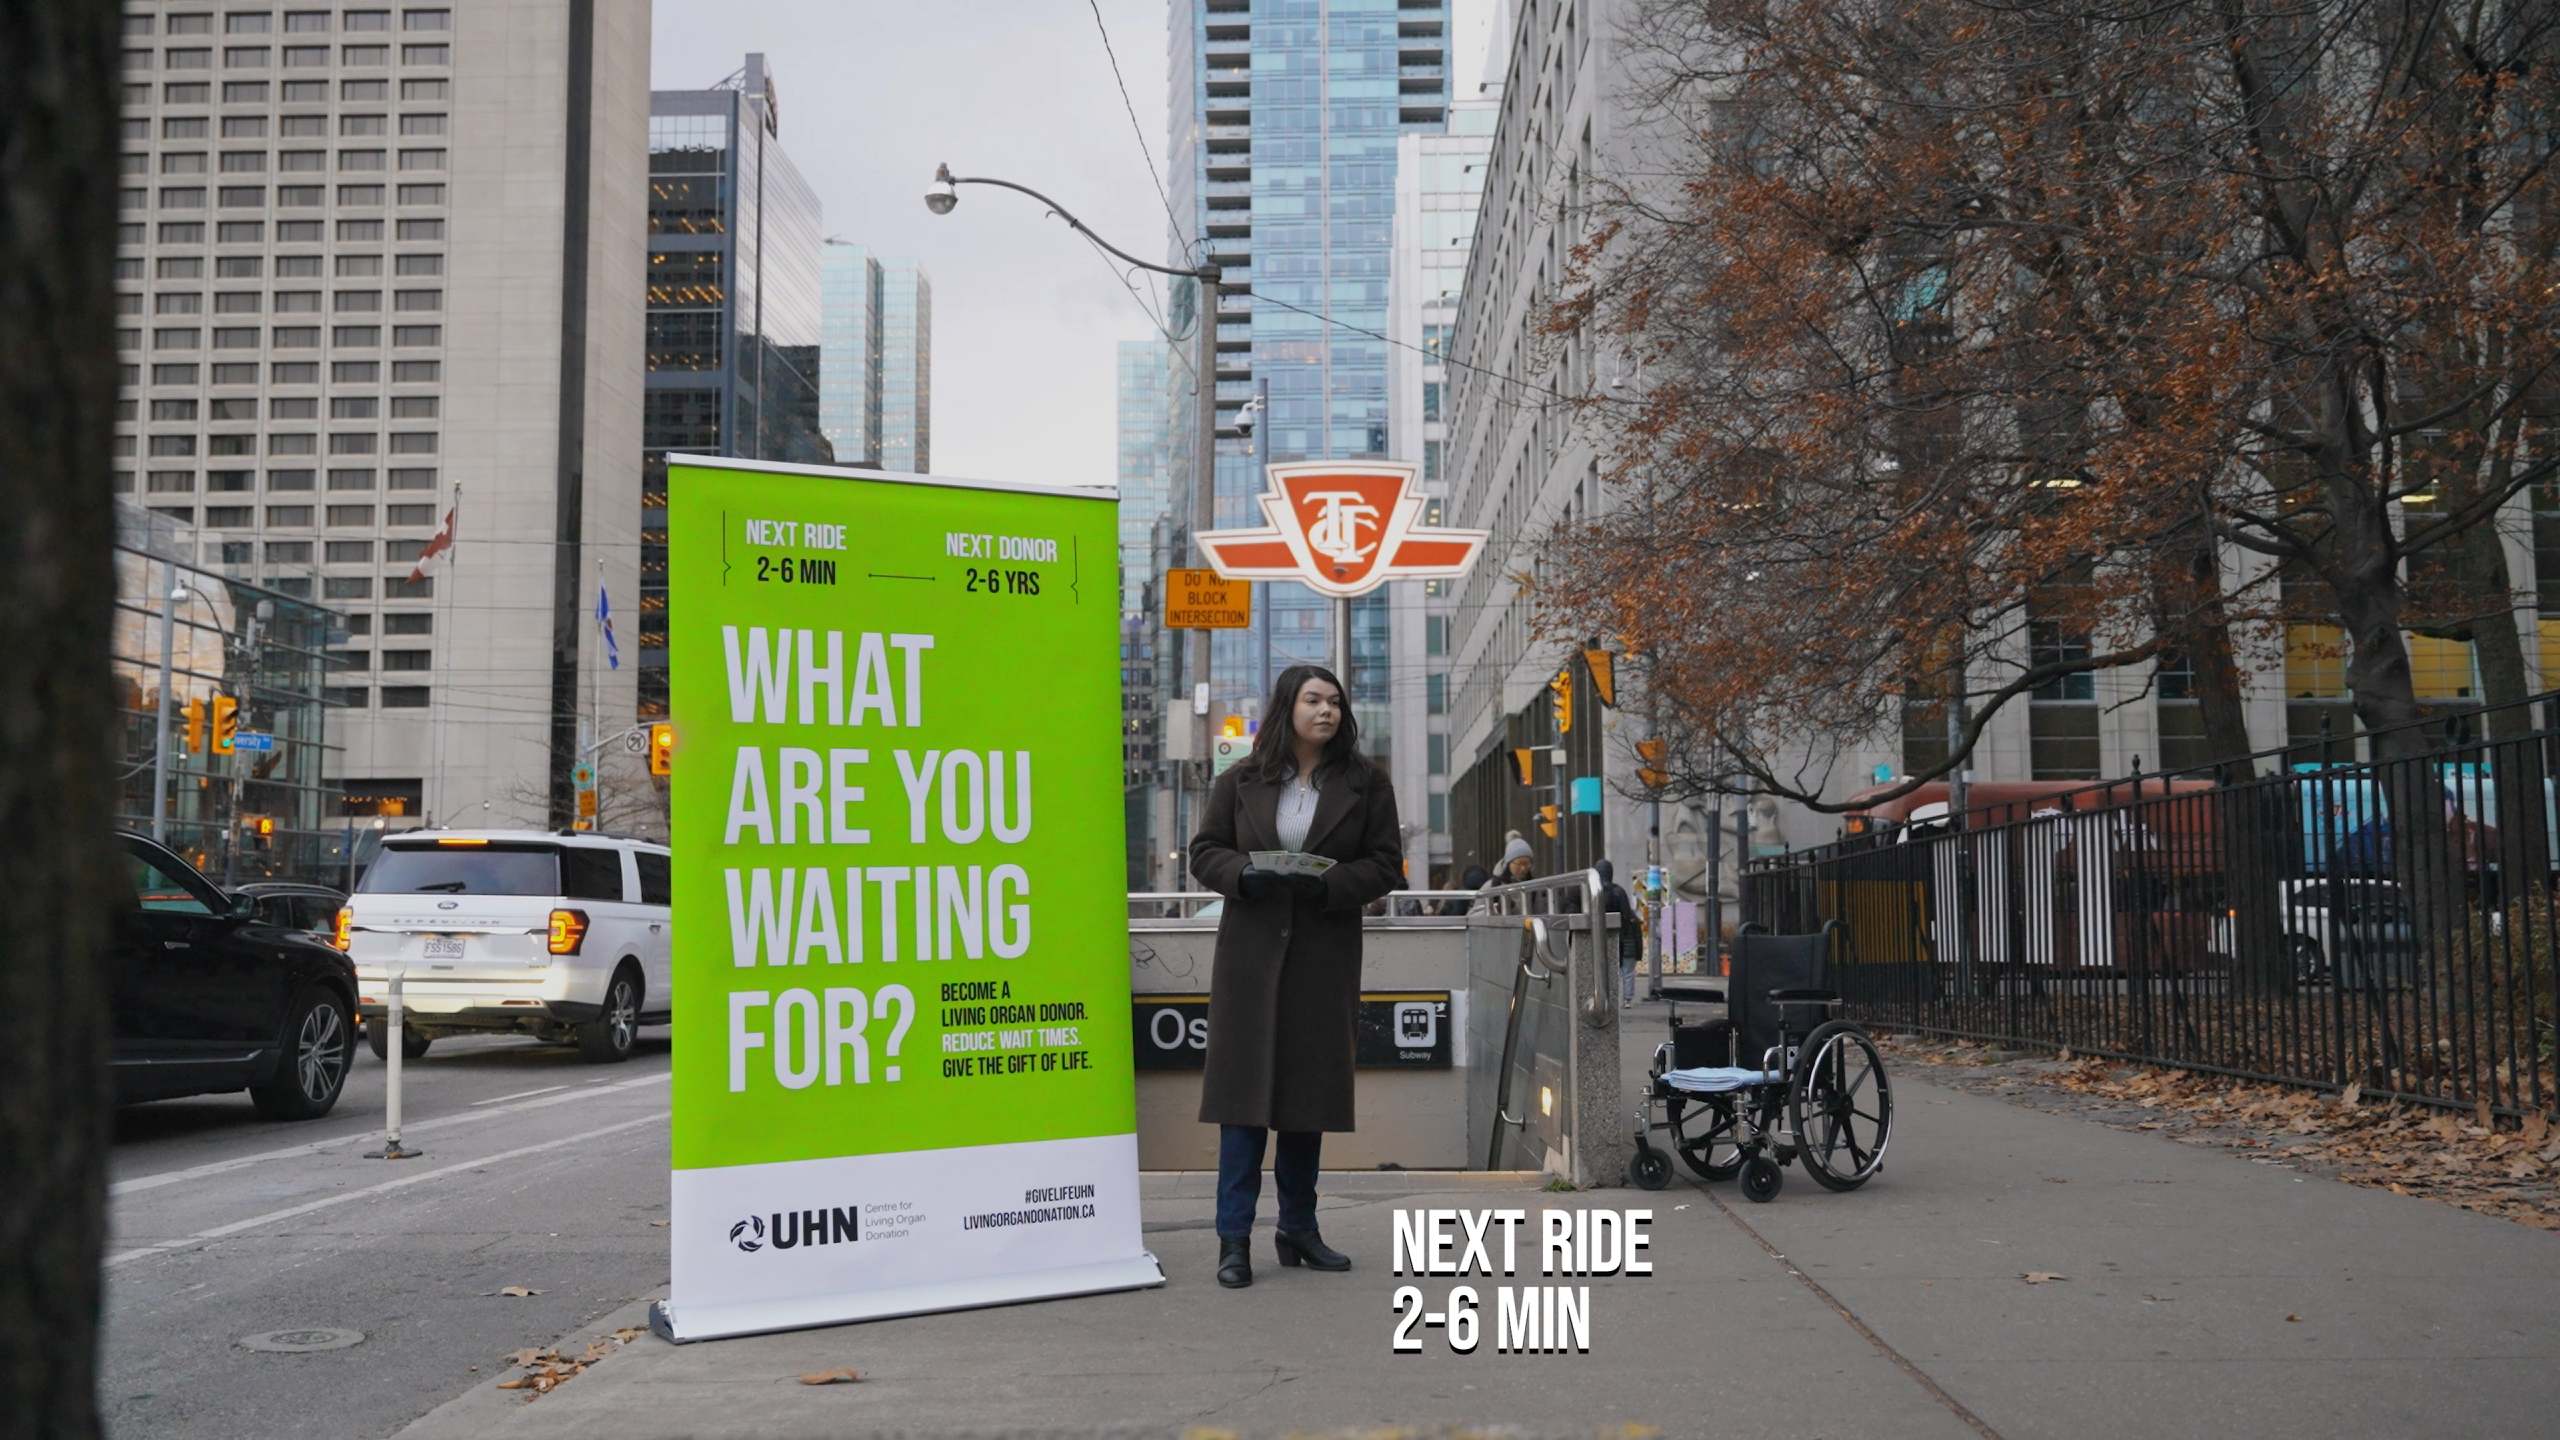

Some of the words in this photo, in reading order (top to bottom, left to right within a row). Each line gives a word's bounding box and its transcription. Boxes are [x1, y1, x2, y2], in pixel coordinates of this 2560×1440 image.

[747, 519, 798, 545] NEXT
[805, 523, 847, 550] RIDE
[947, 533, 992, 557] NEXT
[999, 536, 1057, 561] DONOR
[758, 557, 793, 583] 2-6
[801, 559, 835, 585] MIN
[967, 568, 999, 593] 2-6
[1006, 571, 1039, 595] YRS
[1184, 573, 1201, 586] DO
[1188, 592, 1227, 605] BLOCK
[1170, 610, 1245, 625] INTERSECTION
[723, 625, 934, 727] WHAT
[724, 746, 870, 844] ARE
[894, 749, 1031, 844] YOU
[725, 864, 1030, 967] WAITING
[942, 982, 997, 1001] BECOME
[1002, 981, 1010, 998] A
[942, 1007, 985, 1027] LIVING
[990, 1005, 1035, 1024] ORGAN
[1040, 1003, 1087, 1021] DONOR.
[729, 984, 915, 1092] FOR?
[943, 1032, 994, 1052] REDUCE
[1000, 1030, 1033, 1048] WAIT
[1038, 1027, 1081, 1046] TIMES.
[1151, 1008, 1209, 1050] Os
[943, 1058, 973, 1077] GIVE
[978, 1056, 1003, 1074] THE
[1008, 1054, 1036, 1073] GIFT
[1041, 1053, 1056, 1071] OF
[1062, 1051, 1092, 1070] LIFE.
[1400, 1051, 1431, 1061] Subway
[1025, 1184, 1094, 1203] #GIVELIFEUHN
[865, 1203, 897, 1214] Centre
[899, 1201, 912, 1211] for
[865, 1217, 894, 1228] Living
[896, 1213, 926, 1225] Organ
[964, 1204, 1095, 1230] LIVINGORGANDONATION.CA
[772, 1206, 858, 1249] UHN
[866, 1229, 909, 1241] Donation
